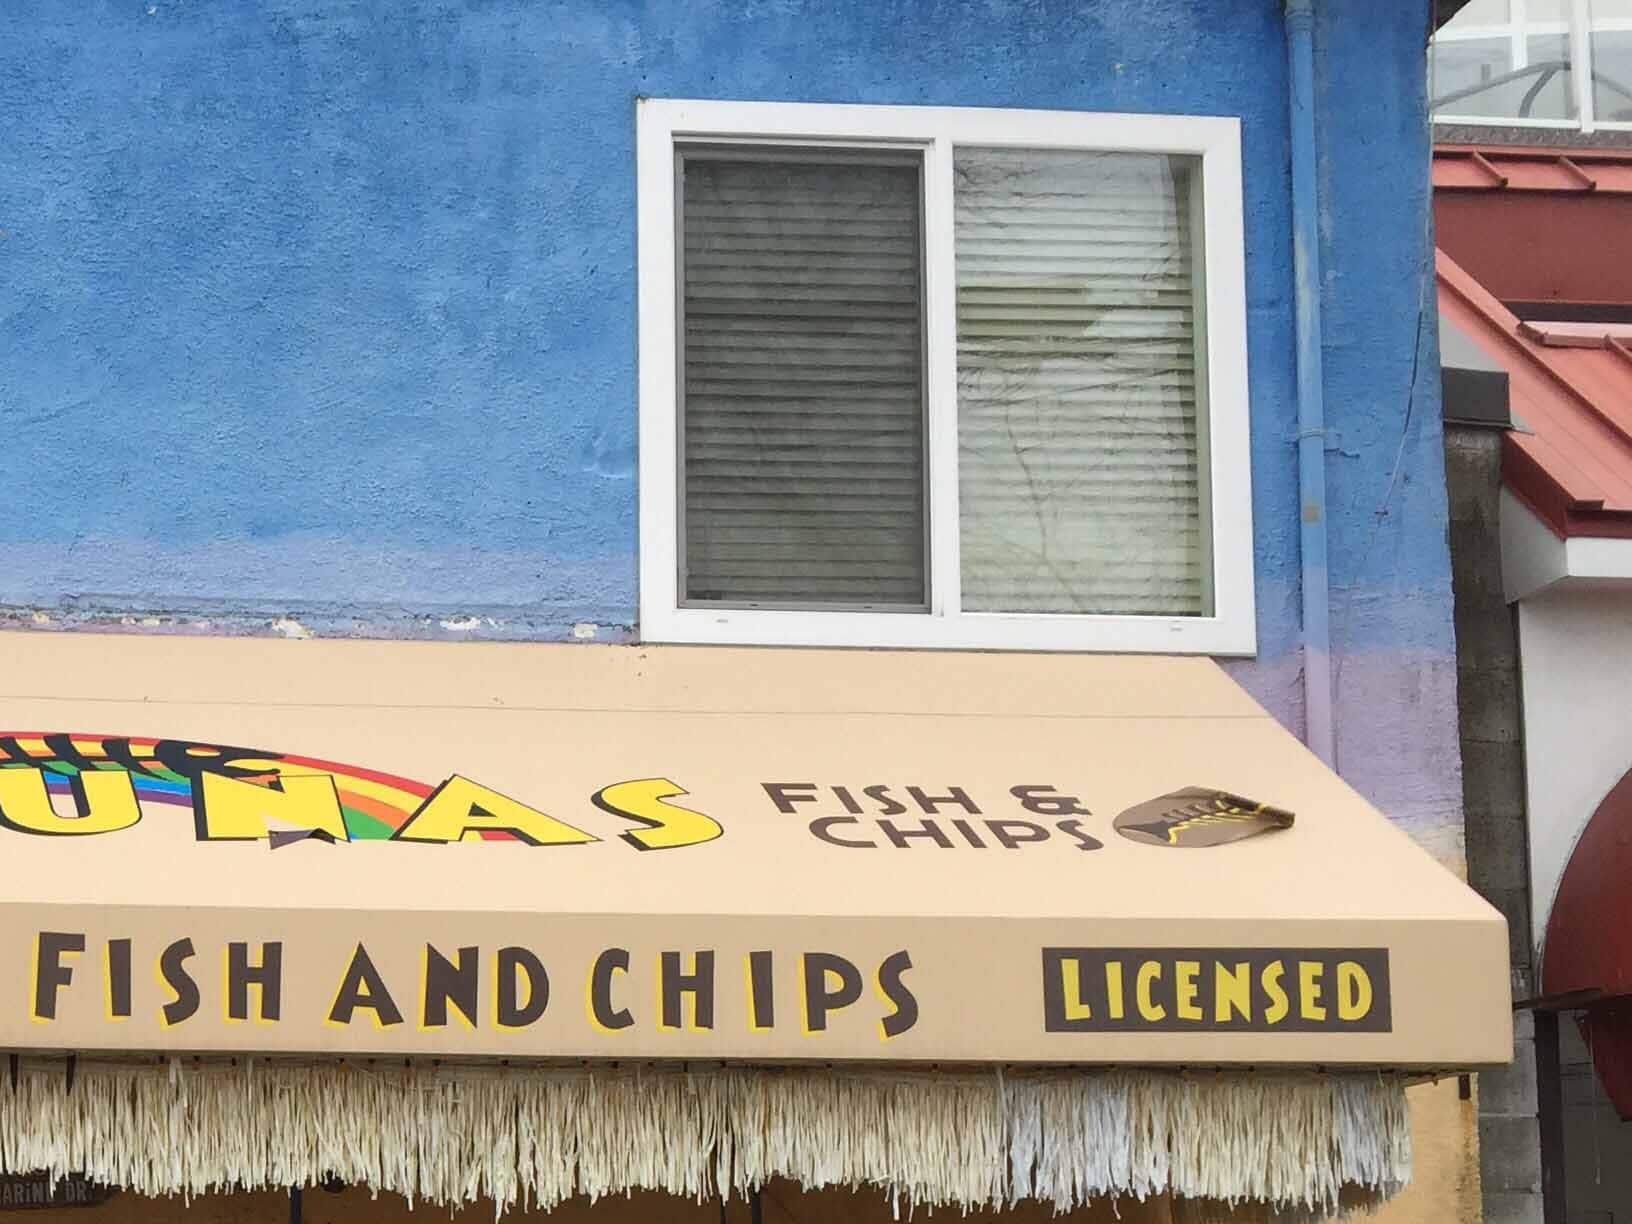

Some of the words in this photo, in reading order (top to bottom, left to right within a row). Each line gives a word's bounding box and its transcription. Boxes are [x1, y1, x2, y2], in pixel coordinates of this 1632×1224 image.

[760, 782, 983, 815] FISH
[1011, 785, 1093, 816] &
[809, 816, 1104, 852] CHIPS
[32, 931, 283, 1027] FISH
[323, 941, 550, 1031] AND
[585, 947, 920, 1041] CHIPS
[1060, 958, 1374, 1025] LICENSED
